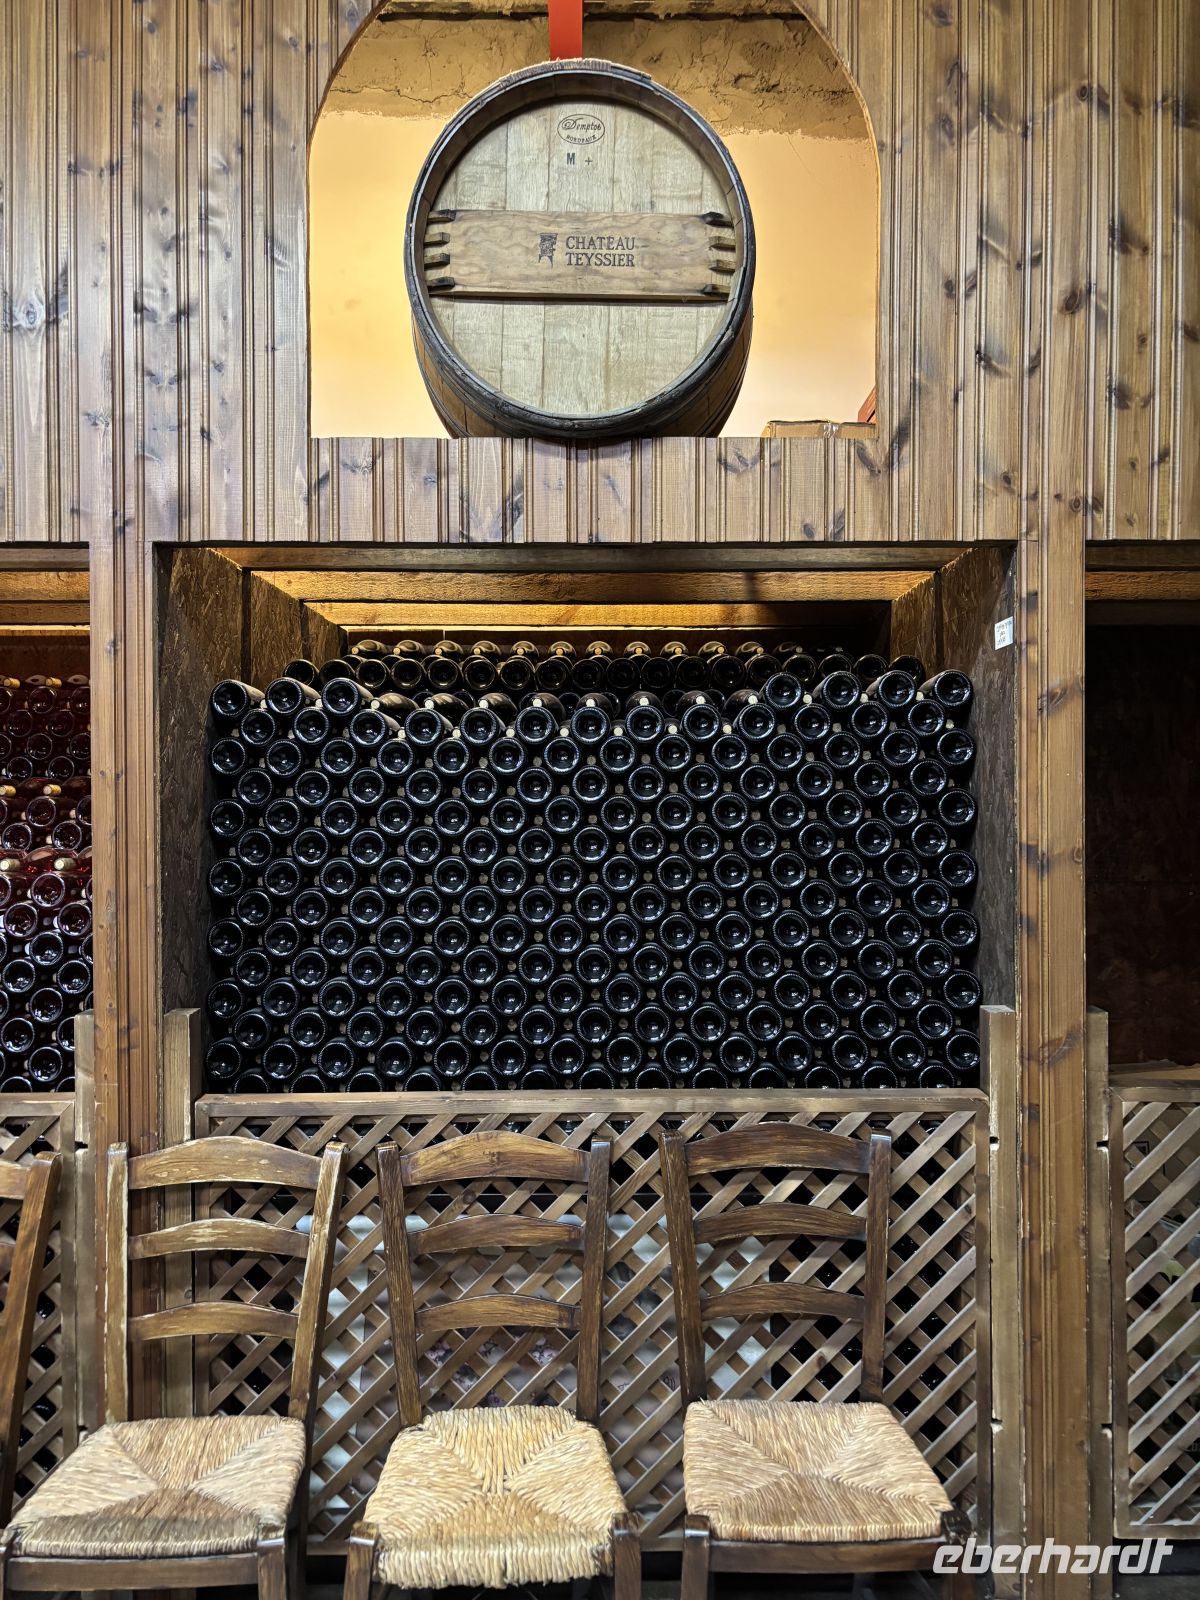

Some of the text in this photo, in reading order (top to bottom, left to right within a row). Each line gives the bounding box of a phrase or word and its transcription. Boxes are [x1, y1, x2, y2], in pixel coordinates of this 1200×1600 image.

[565, 134, 598, 143] BORDEAUX
[566, 152, 575, 165] M
[565, 235, 636, 250] CHATEAU
[565, 253, 636, 267] TEYSSIER
